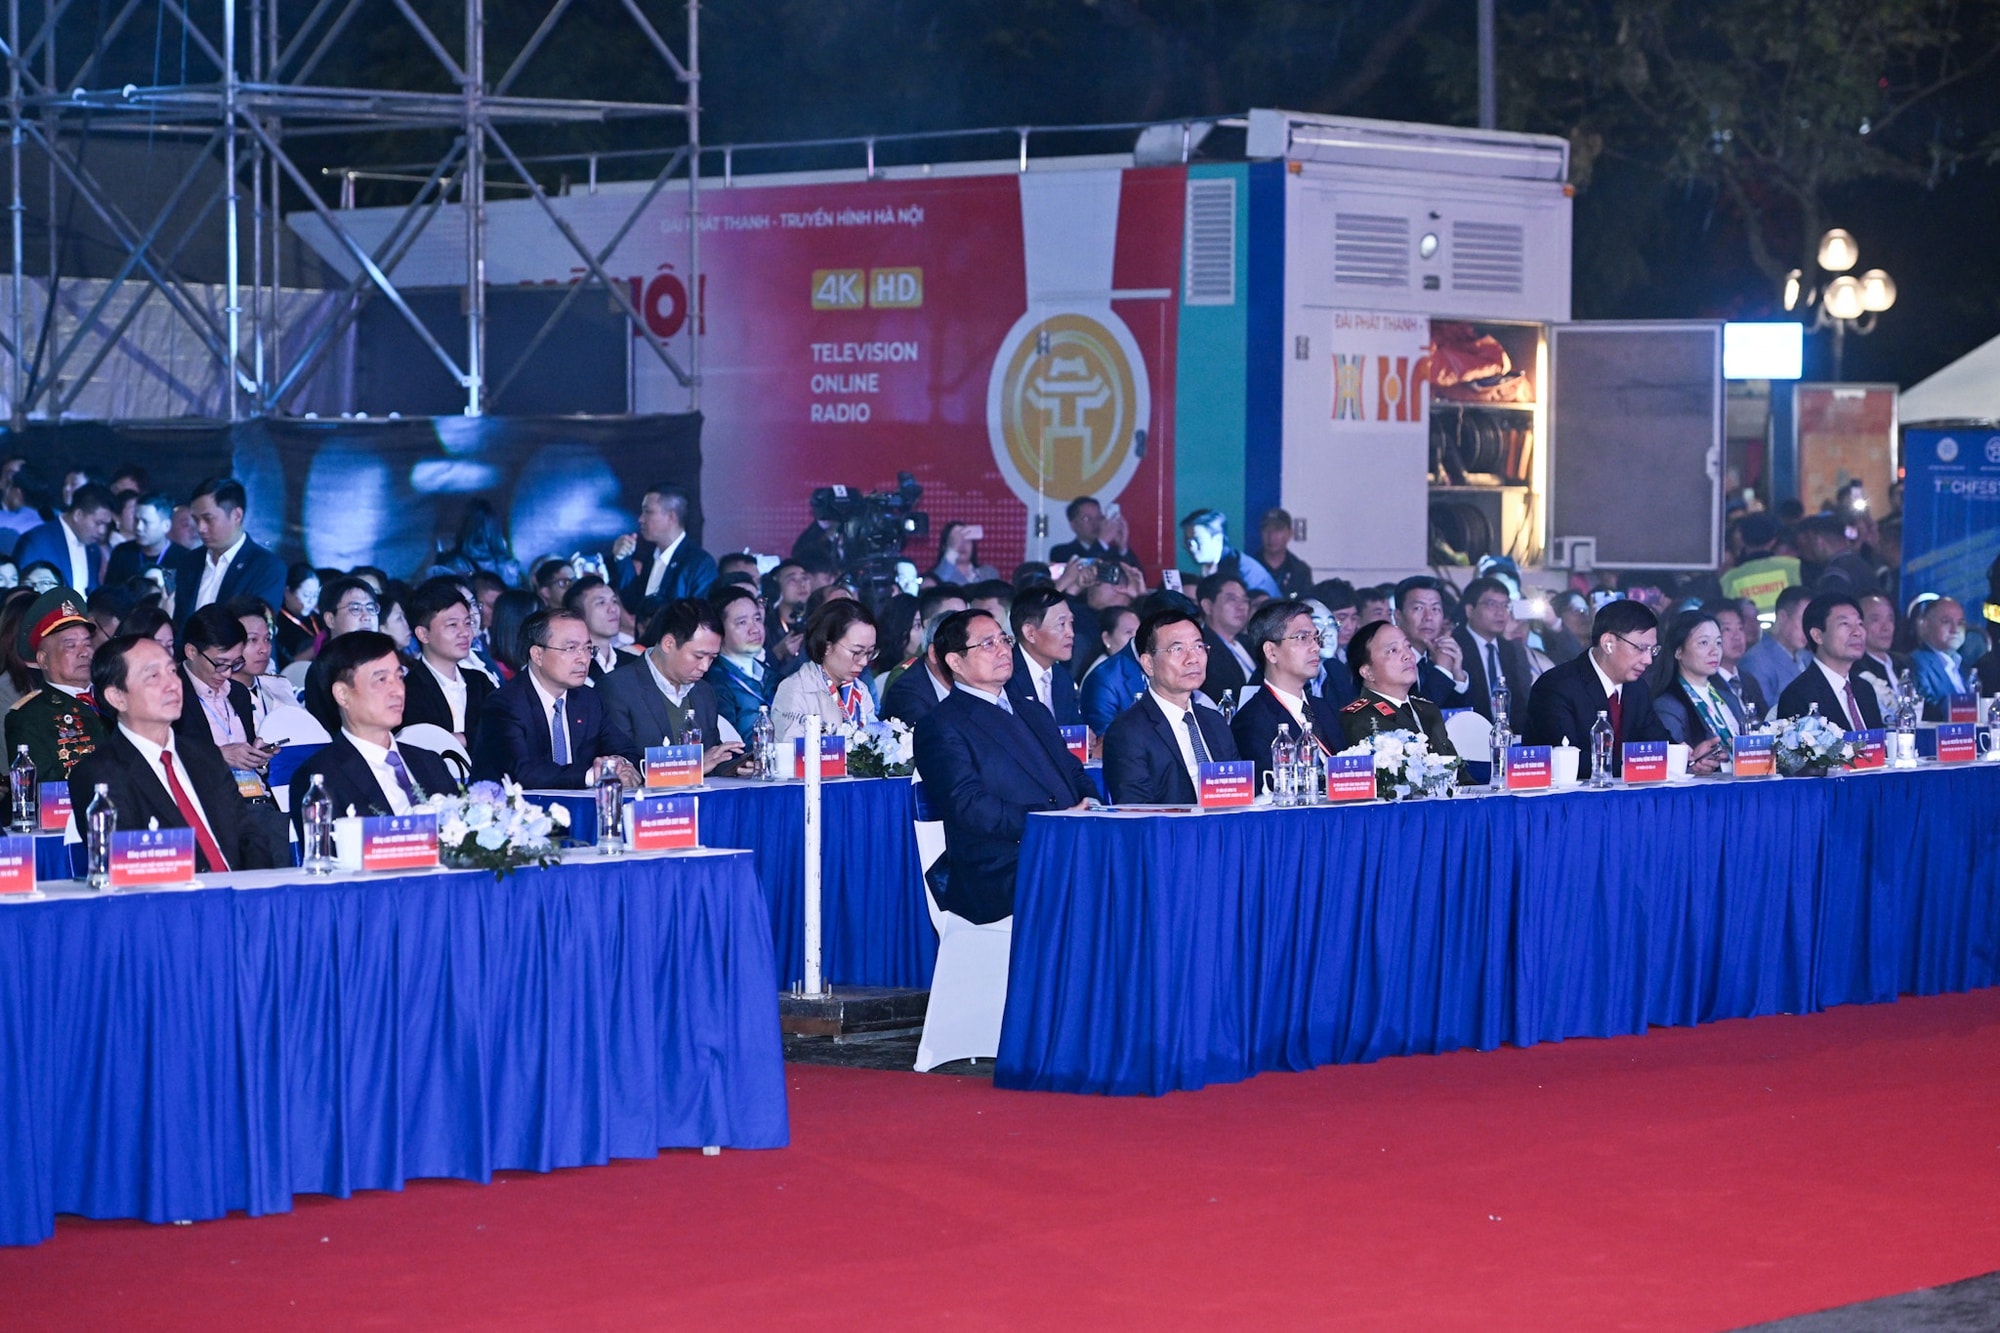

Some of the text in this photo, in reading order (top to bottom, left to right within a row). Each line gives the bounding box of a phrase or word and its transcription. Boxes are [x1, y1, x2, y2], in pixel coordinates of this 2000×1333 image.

[724, 213, 770, 230] THANH
[874, 204, 896, 224] HÀ
[897, 203, 925, 228] NỘI
[816, 272, 917, 304] 4K HD
[810, 341, 919, 363] TELEVISION
[810, 373, 880, 394] ONLINE
[811, 402, 871, 423] RADIO
